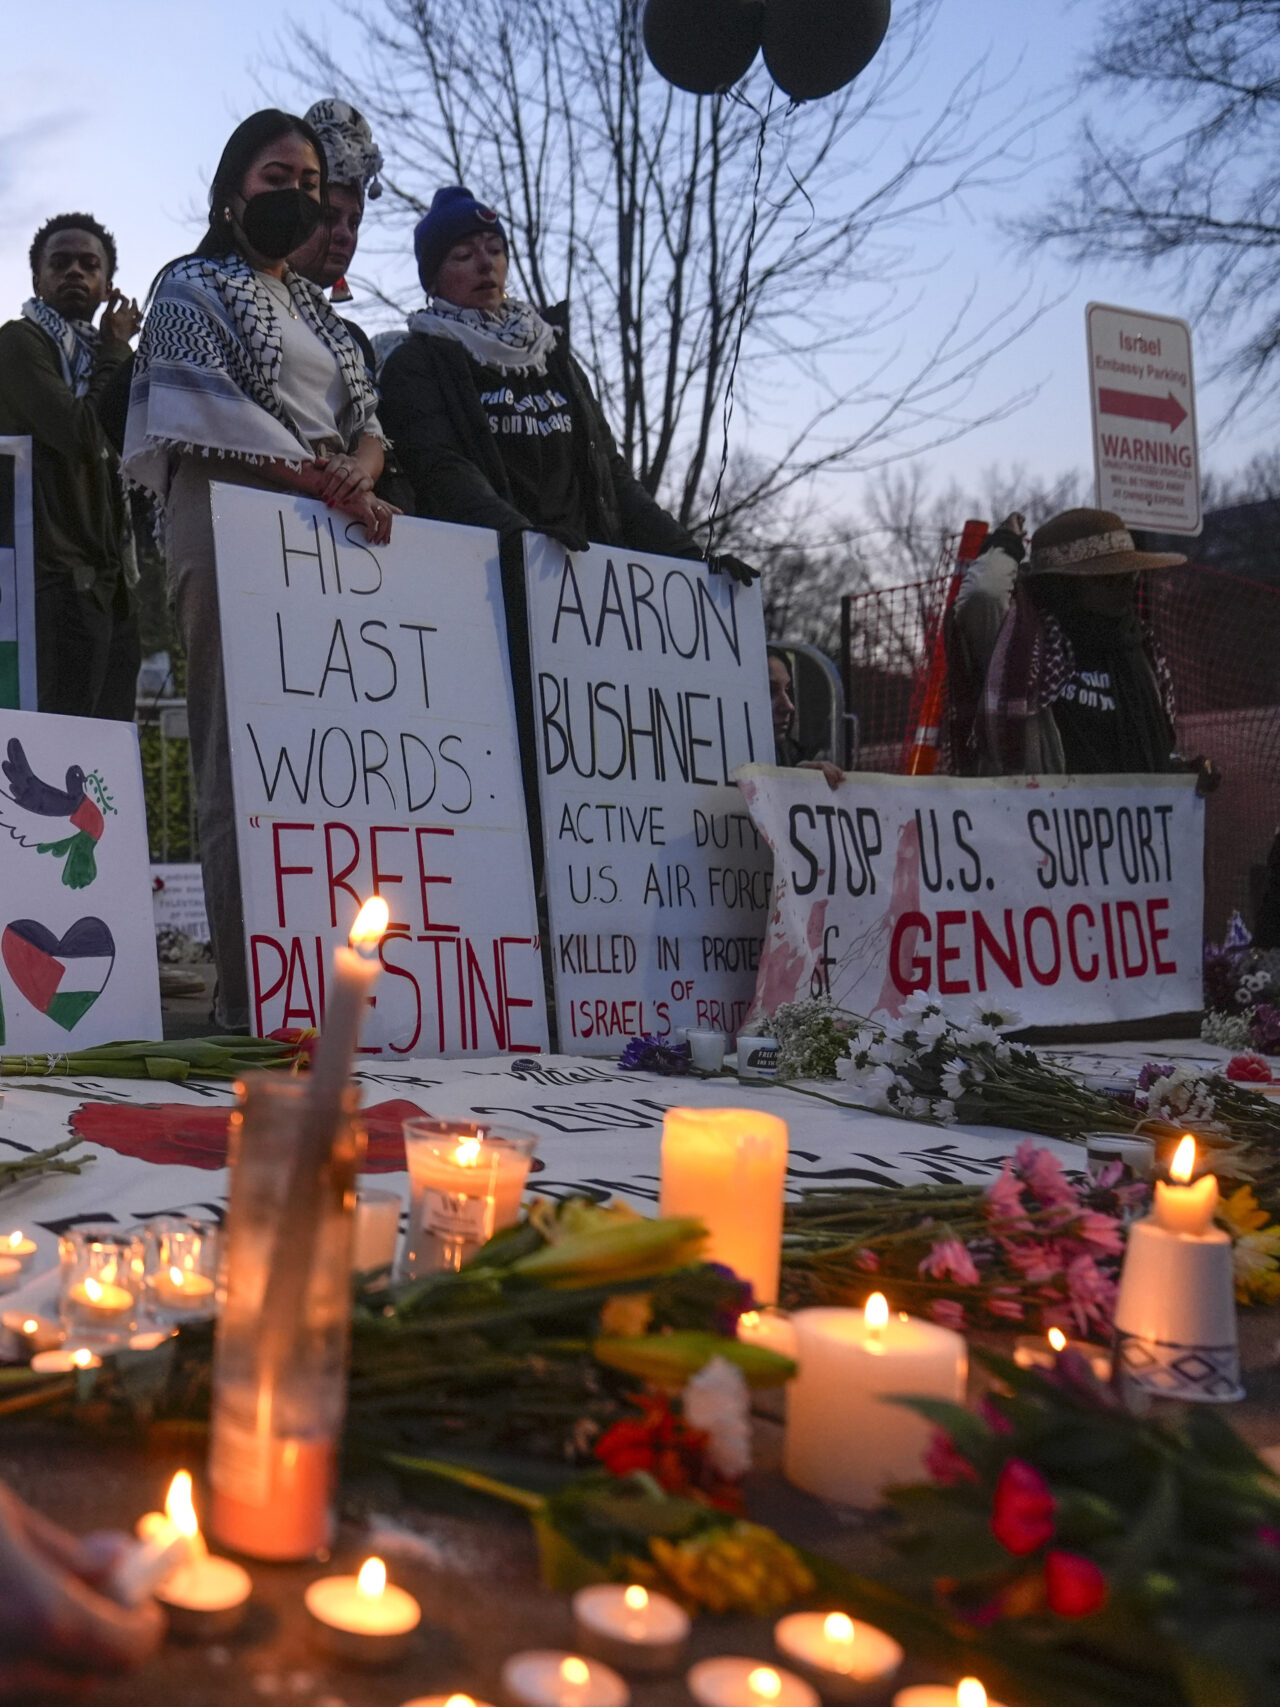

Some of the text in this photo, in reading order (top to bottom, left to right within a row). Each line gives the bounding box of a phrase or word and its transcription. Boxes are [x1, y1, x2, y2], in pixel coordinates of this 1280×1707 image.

[1119, 331, 1162, 358] Israel
[1095, 355, 1187, 388] Embassy Parking
[1101, 433, 1192, 468] WARNING
[278, 510, 383, 596] HIS
[551, 554, 741, 667] AARON
[276, 611, 438, 709] LAST
[558, 802, 760, 850] ACTIVE DUTY
[788, 804, 1174, 897] STOP U.S. SUPPORT
[643, 862, 697, 908] AIR
[559, 933, 638, 974] KILLED
[657, 934, 680, 971] IN
[888, 898, 1178, 996] GENOCIDE
[670, 979, 696, 1001] OF
[570, 1000, 671, 1038] ISRAEL'S
